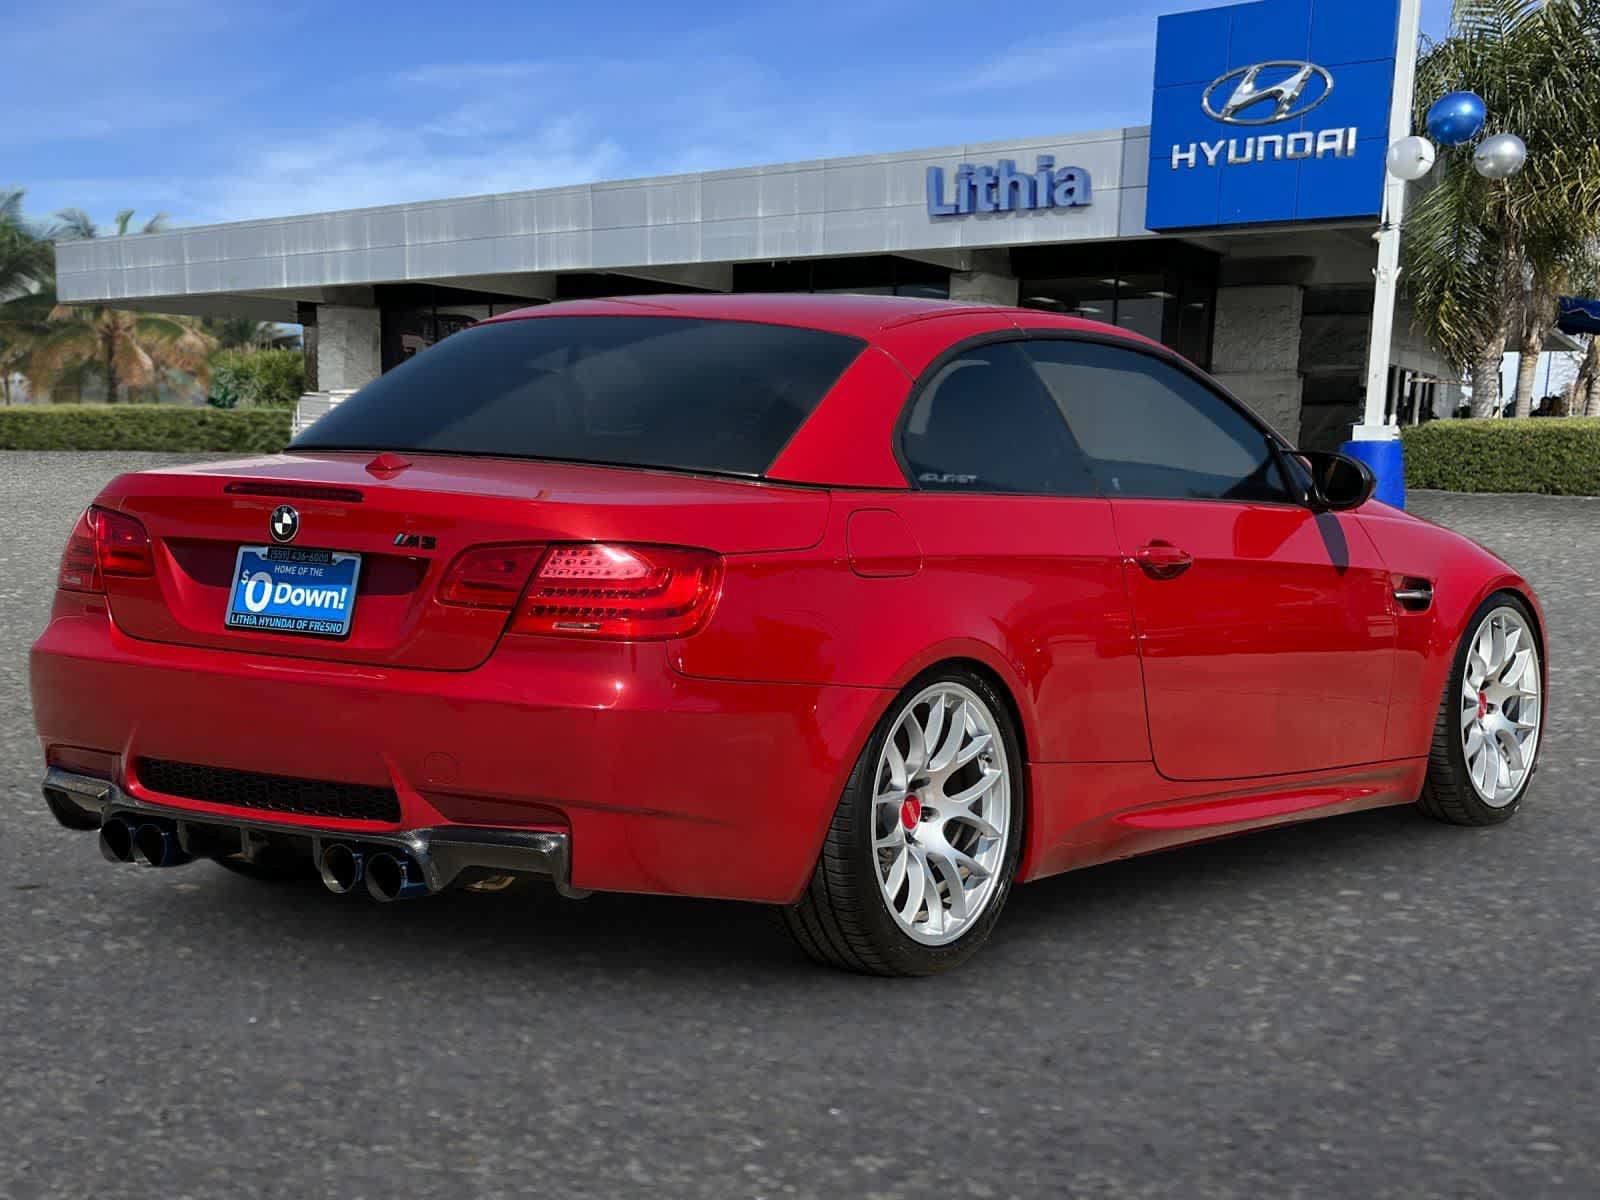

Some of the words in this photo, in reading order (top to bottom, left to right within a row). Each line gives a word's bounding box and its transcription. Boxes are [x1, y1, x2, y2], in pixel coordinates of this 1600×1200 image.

[1171, 127, 1358, 169] HYUNDAI
[926, 154, 1093, 217] Lithia
[274, 565, 297, 575] HOME
[298, 566, 309, 576] OF
[310, 567, 325, 577] THE
[273, 582, 348, 610] Down!
[231, 614, 257, 626] LITHIA
[259, 616, 296, 629] HYUNDAI
[296, 620, 308, 631] OF
[308, 621, 343, 633] FRESNO
